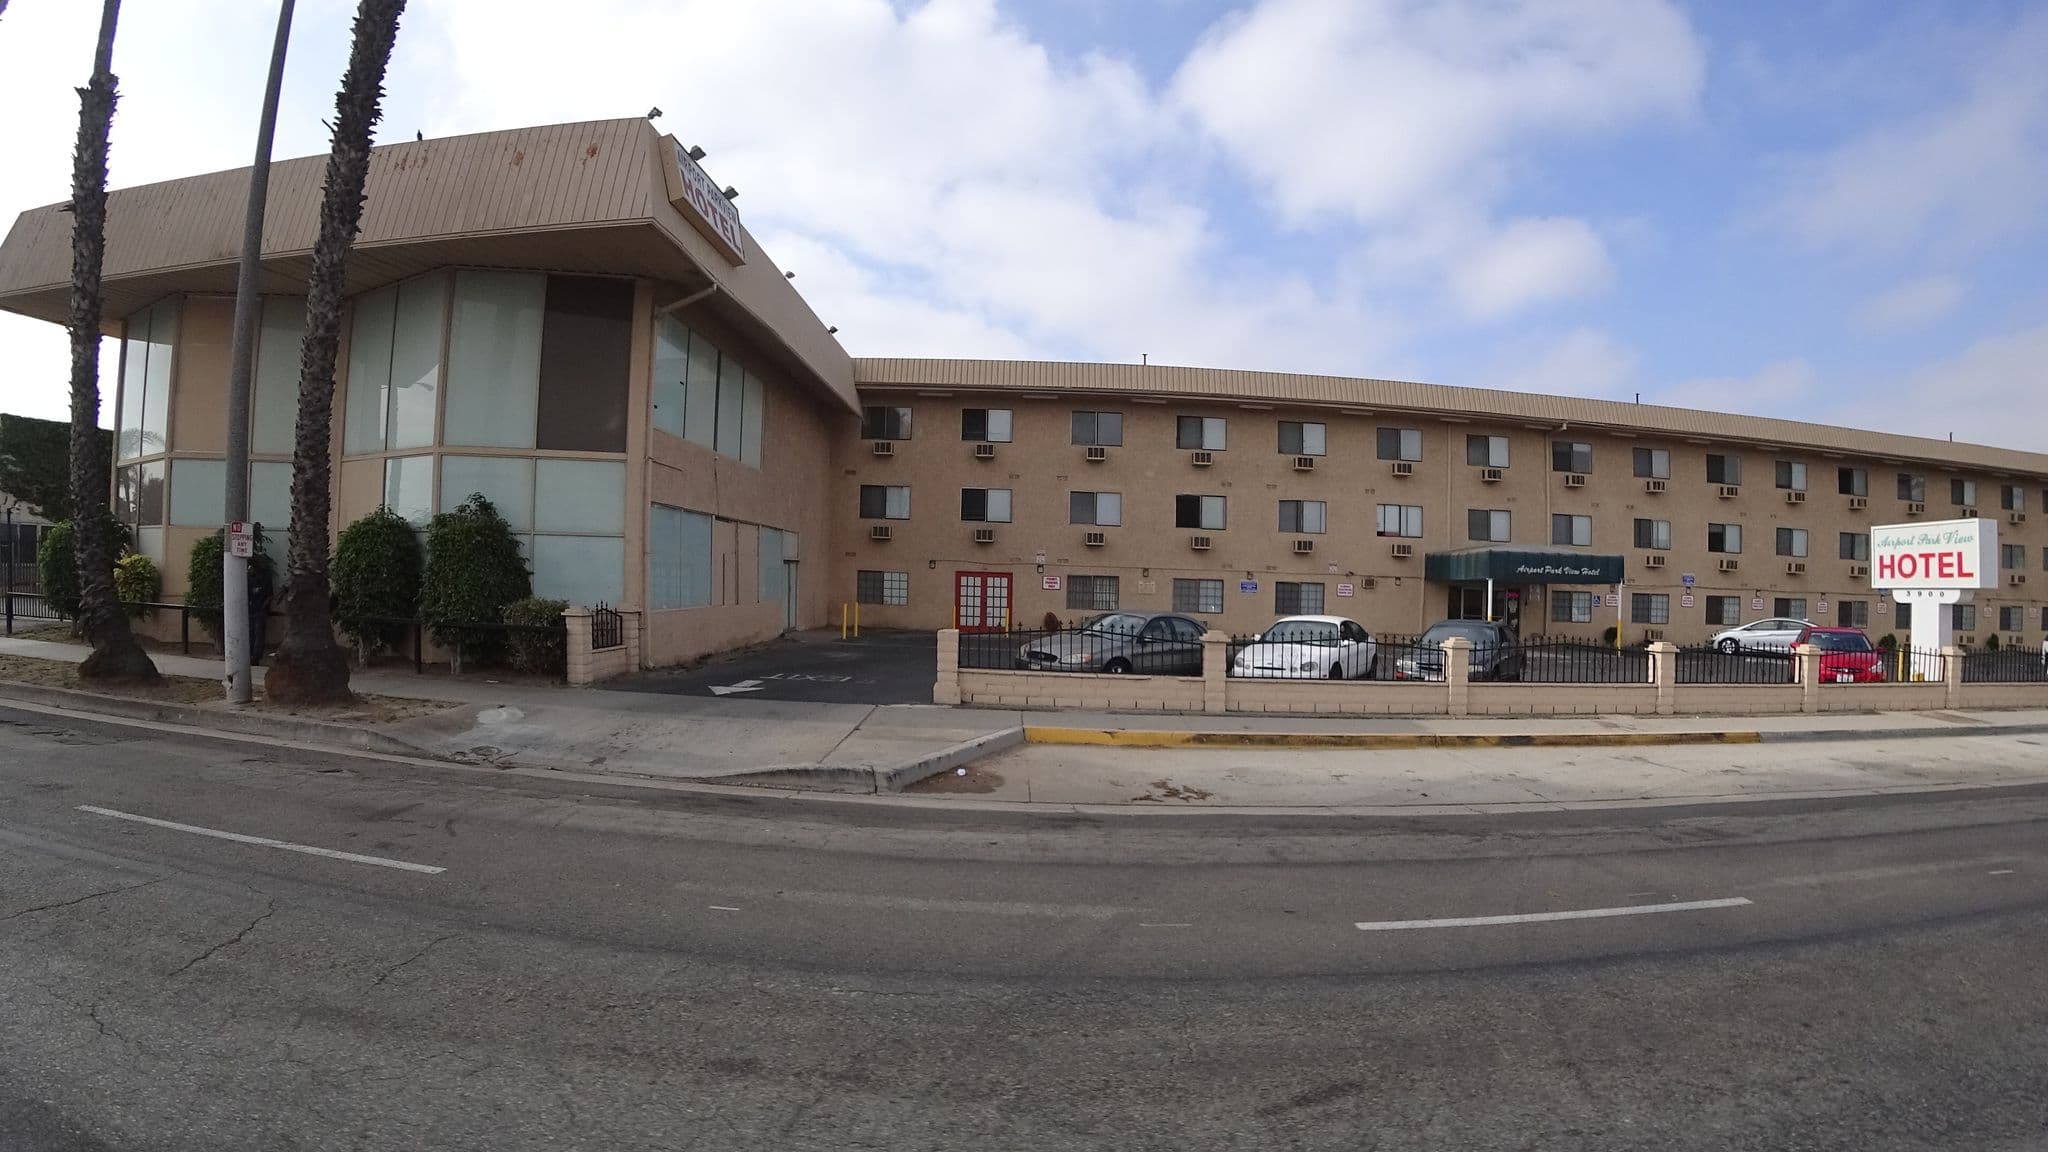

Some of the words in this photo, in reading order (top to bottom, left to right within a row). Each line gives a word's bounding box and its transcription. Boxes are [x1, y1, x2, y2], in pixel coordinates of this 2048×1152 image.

[680, 168, 742, 255] HOTEL
[232, 522, 242, 532] NO
[1877, 535, 1916, 550] Airport
[1917, 533, 1942, 545] Park
[1943, 529, 1974, 545] View
[1515, 564, 1545, 576] Airport
[1544, 565, 1563, 575] Park
[1563, 566, 1581, 575] View
[1580, 567, 1601, 576] Hotel
[1879, 551, 1975, 579] HOTEL
[1906, 590, 1945, 598] 3900
